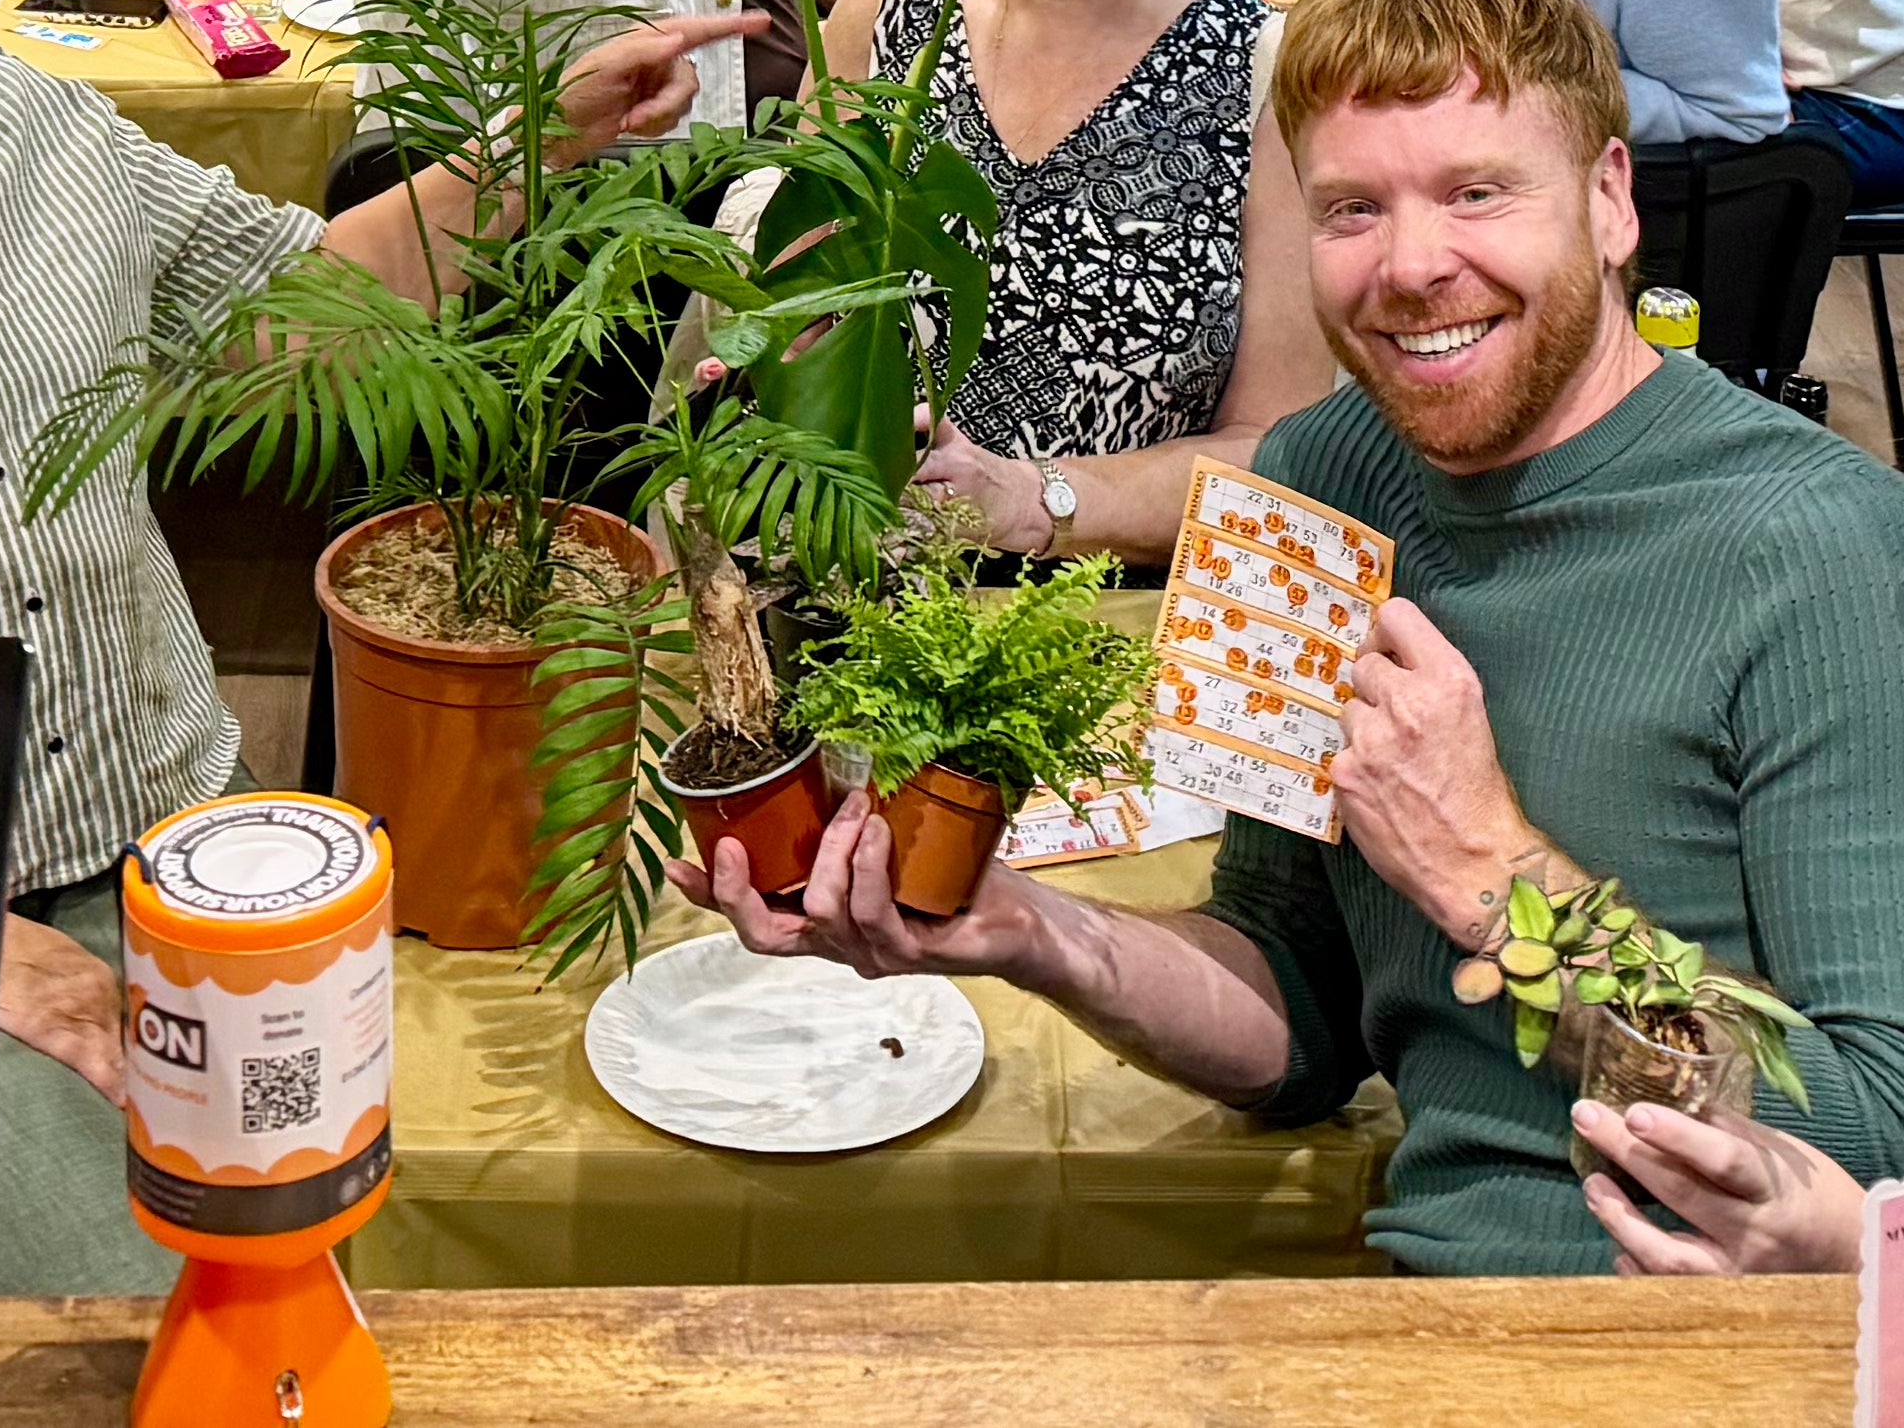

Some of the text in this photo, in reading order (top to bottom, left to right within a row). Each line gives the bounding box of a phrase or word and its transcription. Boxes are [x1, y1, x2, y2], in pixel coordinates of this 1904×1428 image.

[1209, 477, 1219, 489] 5
[1267, 497, 1281, 511] 31
[1303, 529, 1318, 544] 53
[1235, 550, 1250, 565] 25
[1251, 573, 1267, 588] 39
[1202, 605, 1216, 619] 14
[1256, 642, 1274, 656] 44
[1204, 675, 1221, 690] 27
[1220, 700, 1237, 714] 32
[1217, 717, 1234, 732] 35
[1300, 744, 1316, 760] 75
[1165, 750, 1180, 765] 12
[1187, 740, 1204, 754] 21
[1229, 753, 1245, 767] 41
[1180, 774, 1197, 789] 23
[270, 806, 342, 844] THANK
[332, 834, 360, 871] YOU
[156, 850, 222, 910] SUPPORT
[296, 867, 352, 900] FOR
[222, 890, 300, 912] YOUR
[260, 1009, 305, 1025] Scan to
